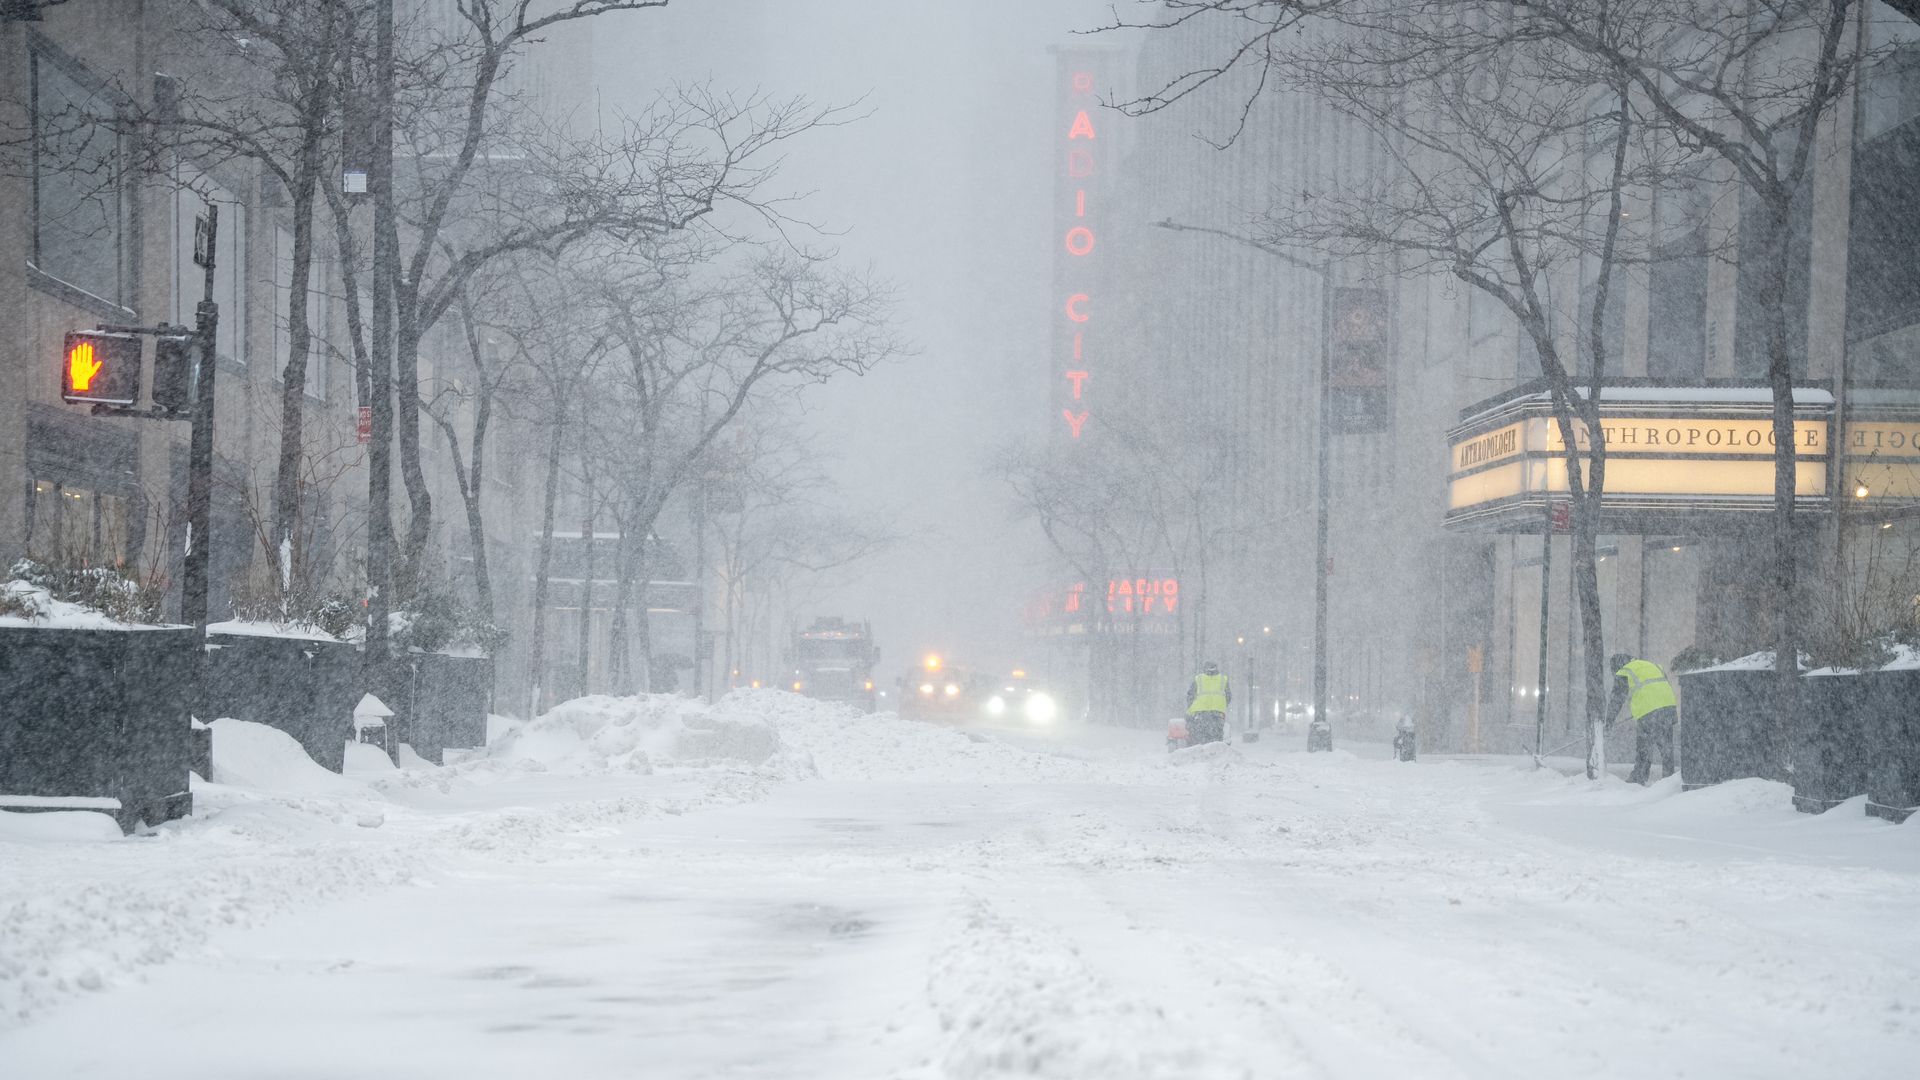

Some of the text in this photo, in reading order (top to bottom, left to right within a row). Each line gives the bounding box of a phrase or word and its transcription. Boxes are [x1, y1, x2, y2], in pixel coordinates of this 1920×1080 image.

[1063, 72, 1095, 439] RADIO CITY
[1459, 428, 1516, 468] ANTHROPOLOGIE
[1557, 427, 1819, 447] NTHROPOLOE
